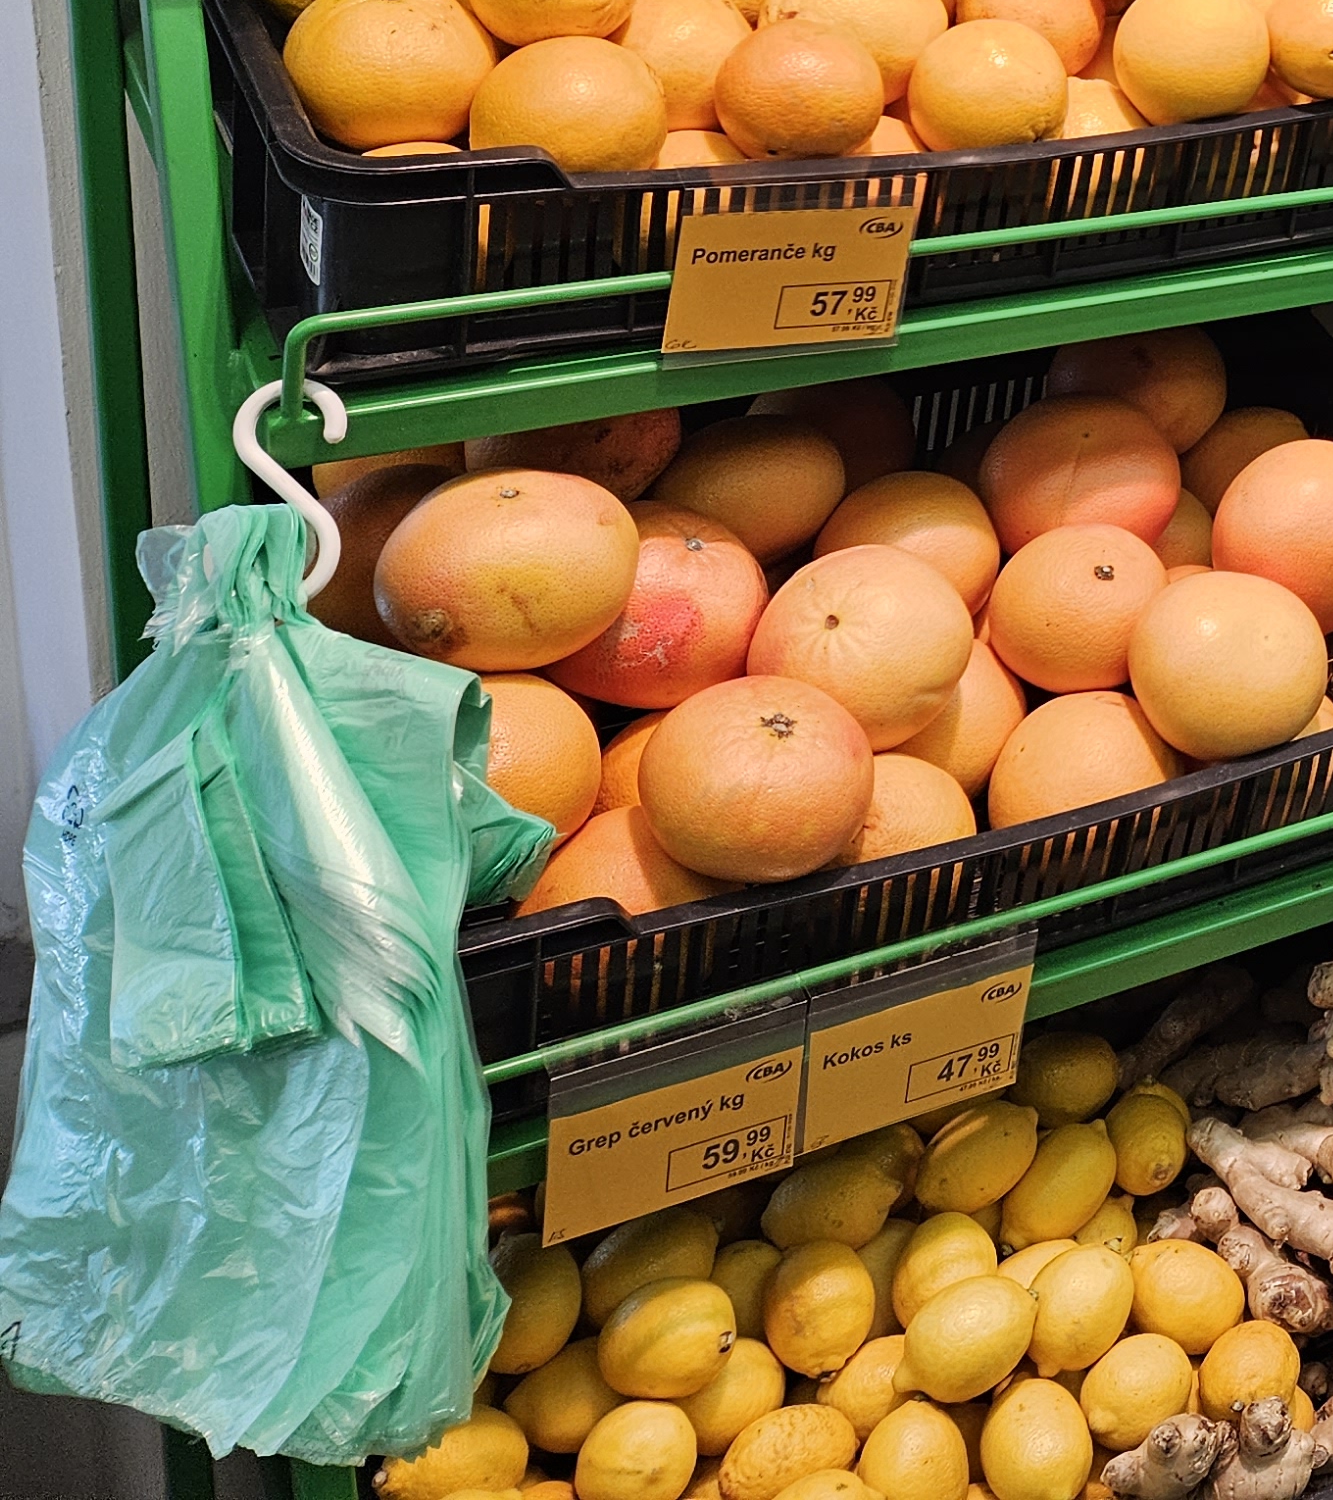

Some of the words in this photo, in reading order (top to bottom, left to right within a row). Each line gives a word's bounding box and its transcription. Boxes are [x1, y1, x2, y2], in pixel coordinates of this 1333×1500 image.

[867, 222, 895, 234] CBA
[691, 244, 806, 264] Pomeranče
[812, 243, 836, 261] kg
[852, 286, 876, 303] 99
[855, 307, 877, 321] Kč
[988, 983, 1015, 999] CBA
[823, 1038, 883, 1069] Kokos
[886, 1031, 912, 1048] ks
[977, 1043, 999, 1062] 99
[753, 1062, 785, 1079] CBA
[981, 1060, 1002, 1076] Kč
[568, 1129, 621, 1158] Grep
[627, 1098, 714, 1138] červený
[719, 1091, 745, 1110] kg
[746, 1126, 771, 1146] 99
[751, 1143, 775, 1162] Kč
